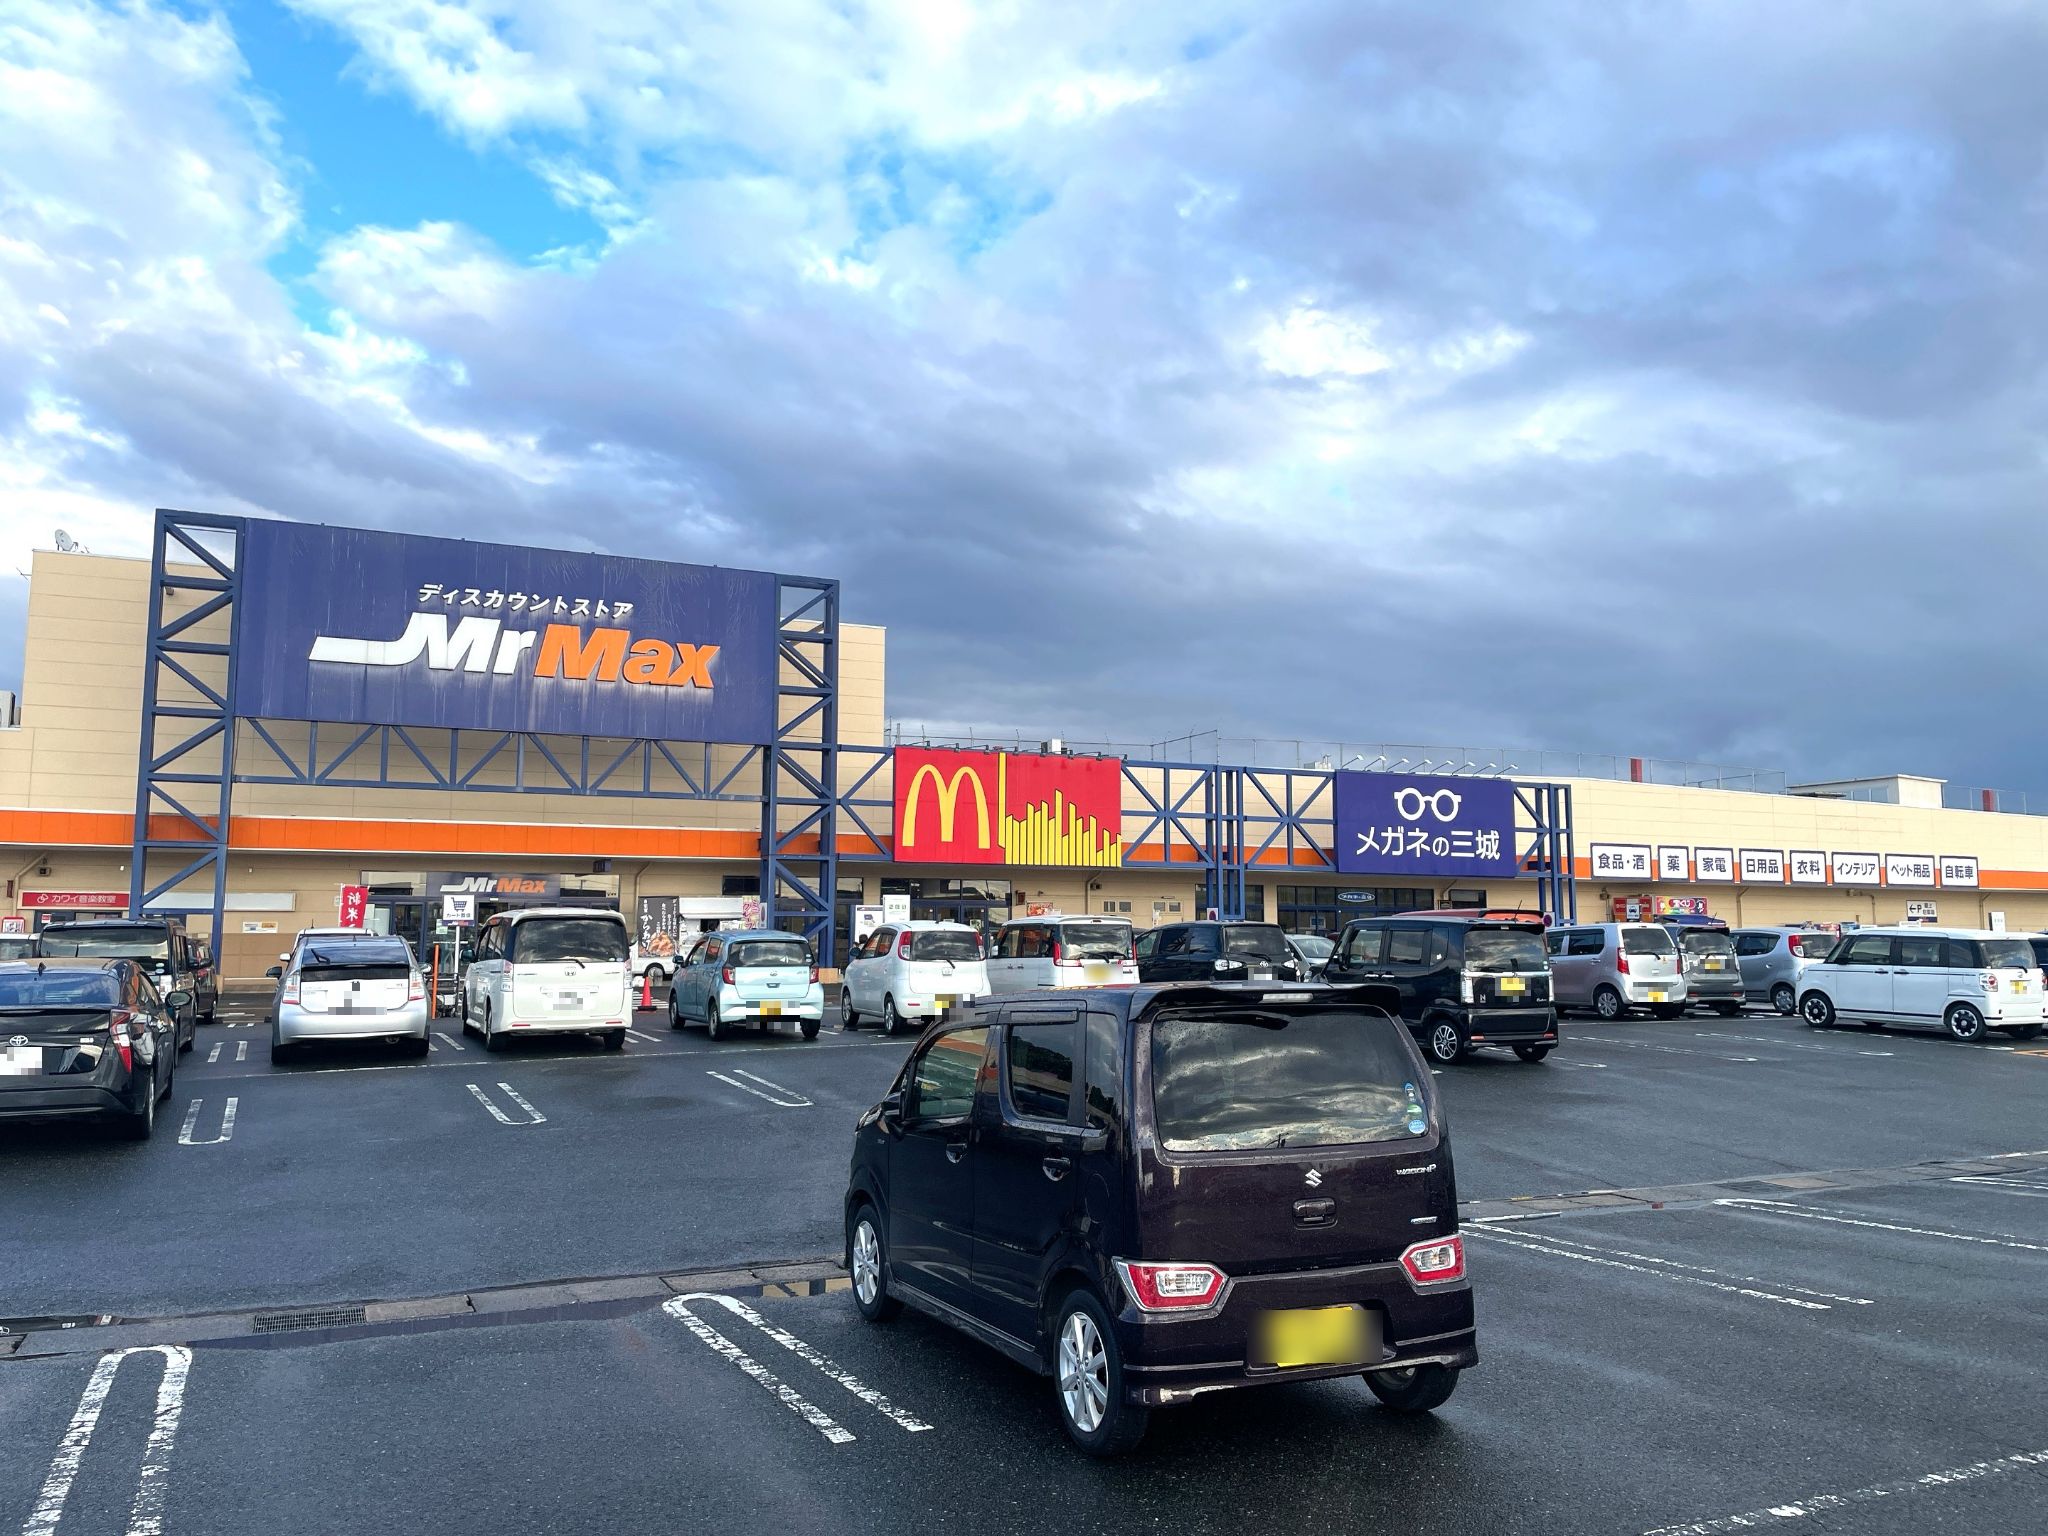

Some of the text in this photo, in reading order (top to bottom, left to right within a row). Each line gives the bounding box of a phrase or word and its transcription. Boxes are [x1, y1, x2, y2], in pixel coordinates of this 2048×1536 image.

[418, 582, 634, 620] ディスカウントストア
[308, 611, 721, 690] MrMax
[1356, 826, 1501, 861] メガネの三城
[1598, 853, 1645, 870] 食品・酒
[1667, 855, 1680, 872] 薬
[1702, 857, 1727, 873] 家電
[1746, 858, 1779, 874] 日用品
[1797, 859, 1821, 875] 衣料
[1837, 862, 1876, 876] インテリア
[1890, 863, 1931, 878] ペット用品
[1945, 864, 1974, 879] 自転車
[440, 876, 547, 894] MrMax
[1916, 904, 1922, 913] P
